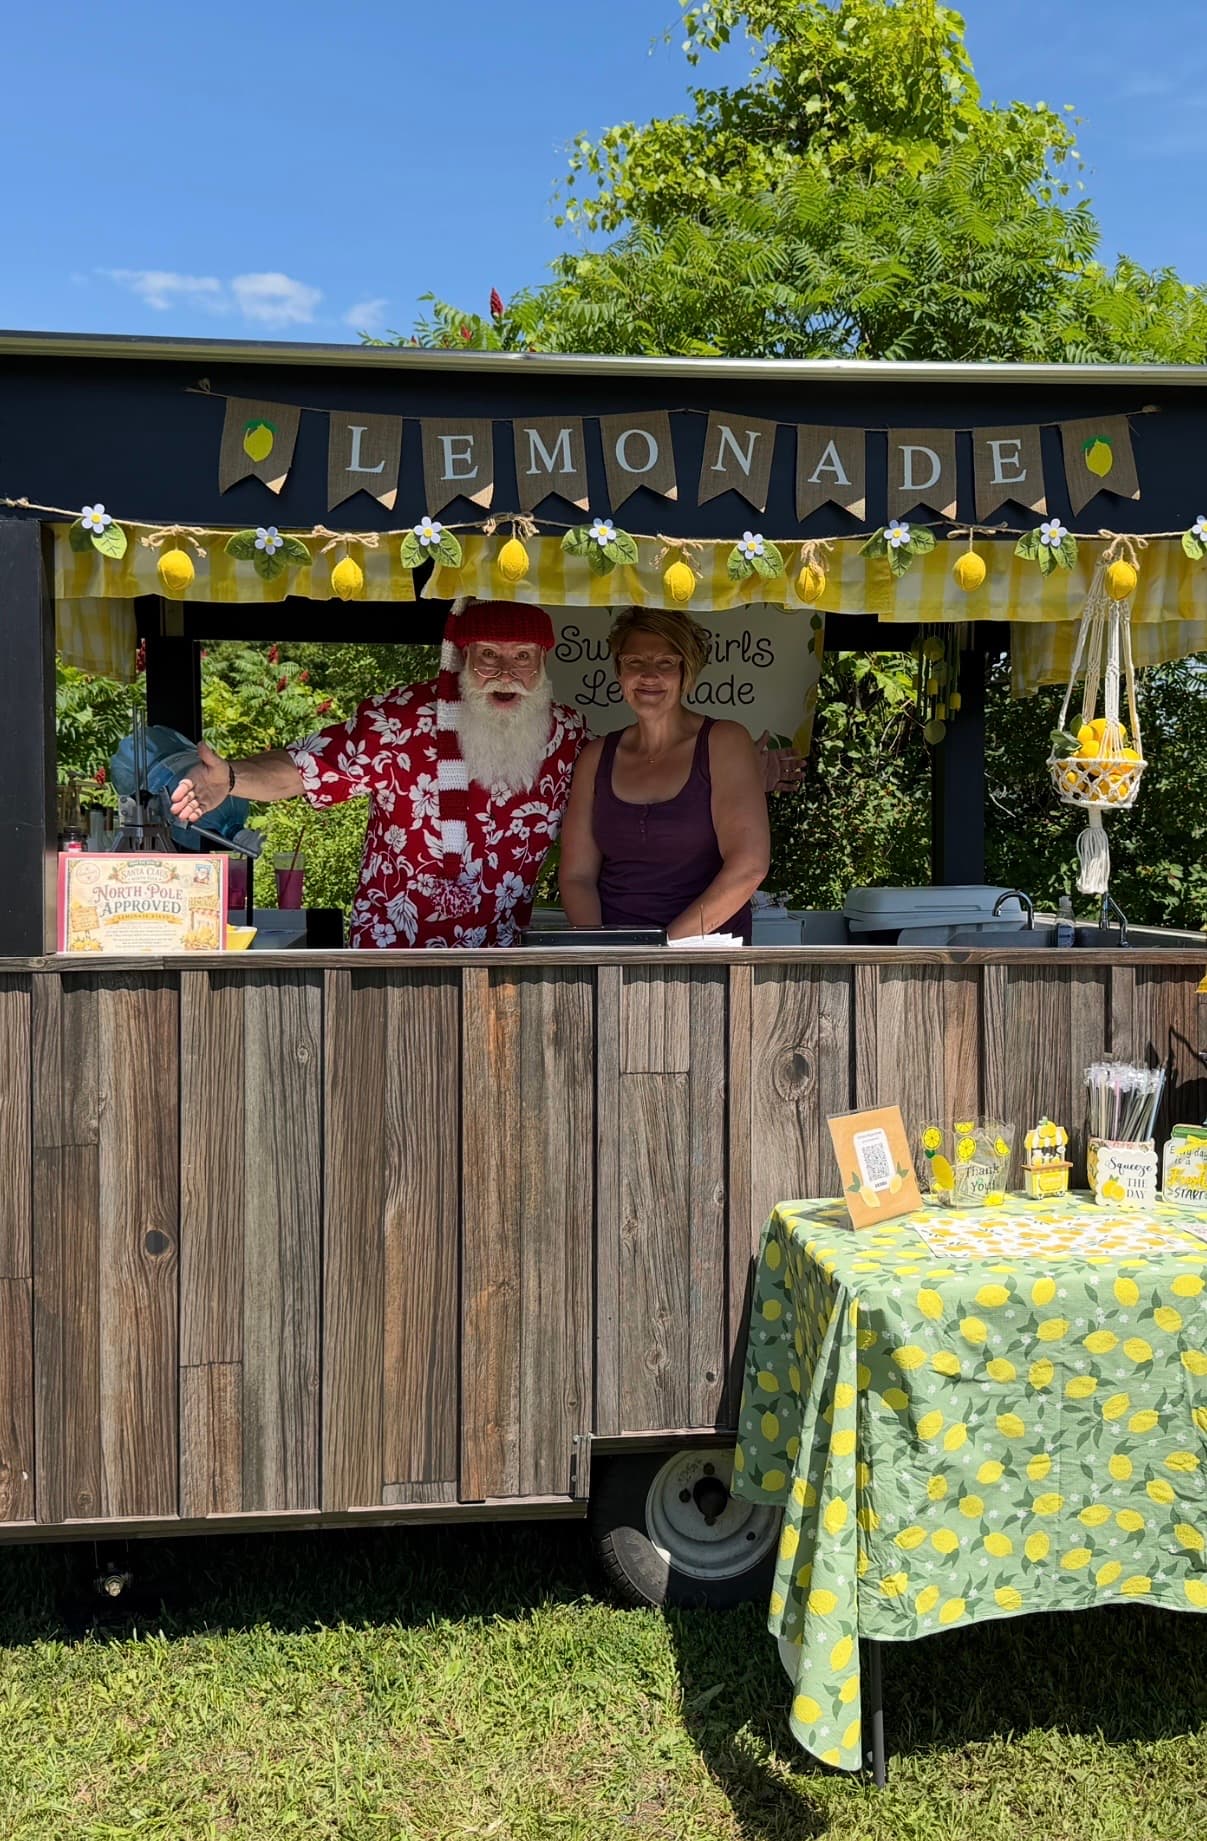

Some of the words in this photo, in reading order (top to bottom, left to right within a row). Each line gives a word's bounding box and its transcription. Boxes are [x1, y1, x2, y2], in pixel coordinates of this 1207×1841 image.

[345, 424, 1028, 491] LEMONADE
[574, 668, 755, 708] Leade
[92, 884, 142, 903] NORTH
[147, 883, 184, 900] POLE
[99, 899, 182, 917] APPROVED
[965, 1162, 1000, 1177] Thank
[1104, 1156, 1153, 1177] Squeeze
[1128, 1177, 1146, 1188] THE
[1126, 1189, 1146, 1200] DAY
[1174, 1187, 1206, 1200] START
